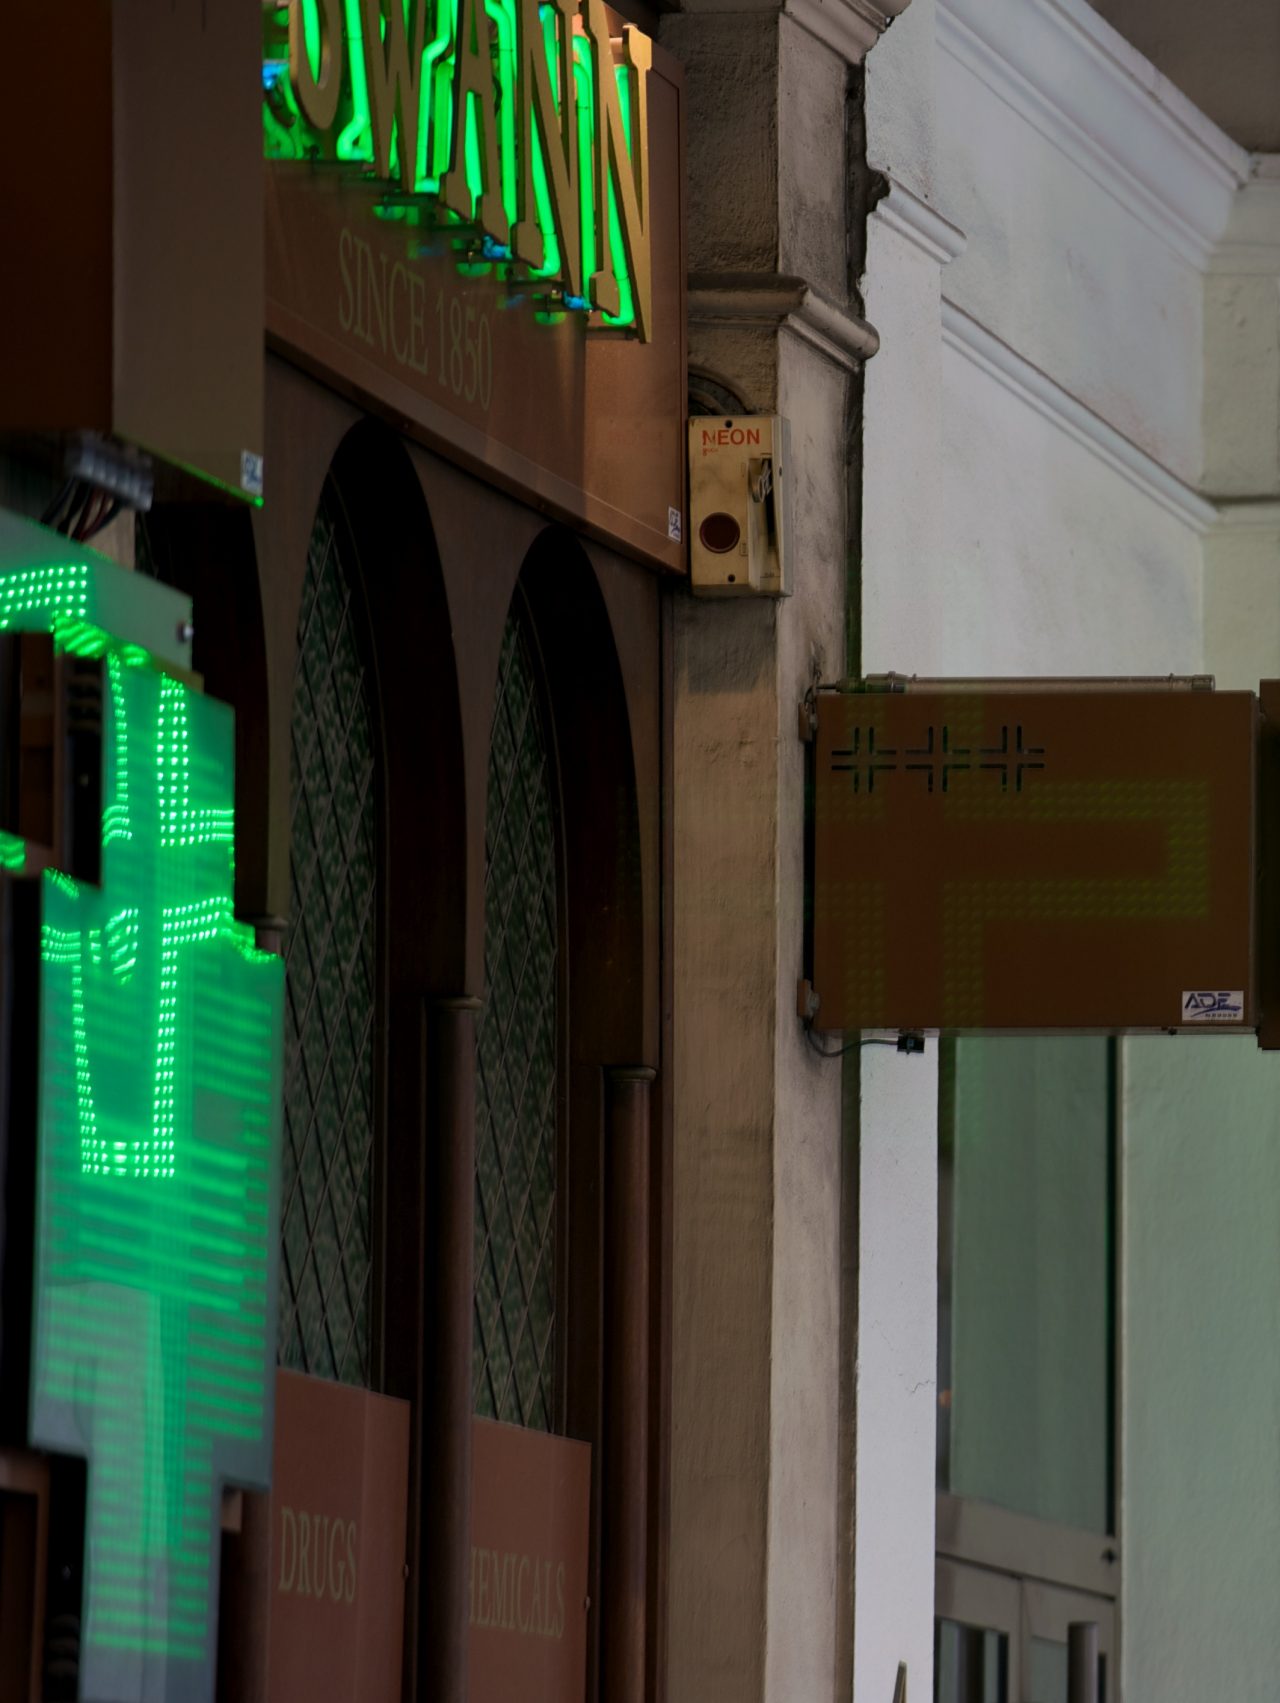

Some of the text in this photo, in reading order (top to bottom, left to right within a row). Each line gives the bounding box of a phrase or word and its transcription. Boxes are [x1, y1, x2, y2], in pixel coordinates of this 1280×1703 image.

[339, 227, 492, 411] SINCE 1850
[701, 428, 760, 446] NEON
[1184, 992, 1239, 1011] ADE
[278, 1505, 357, 1603] DRUGS
